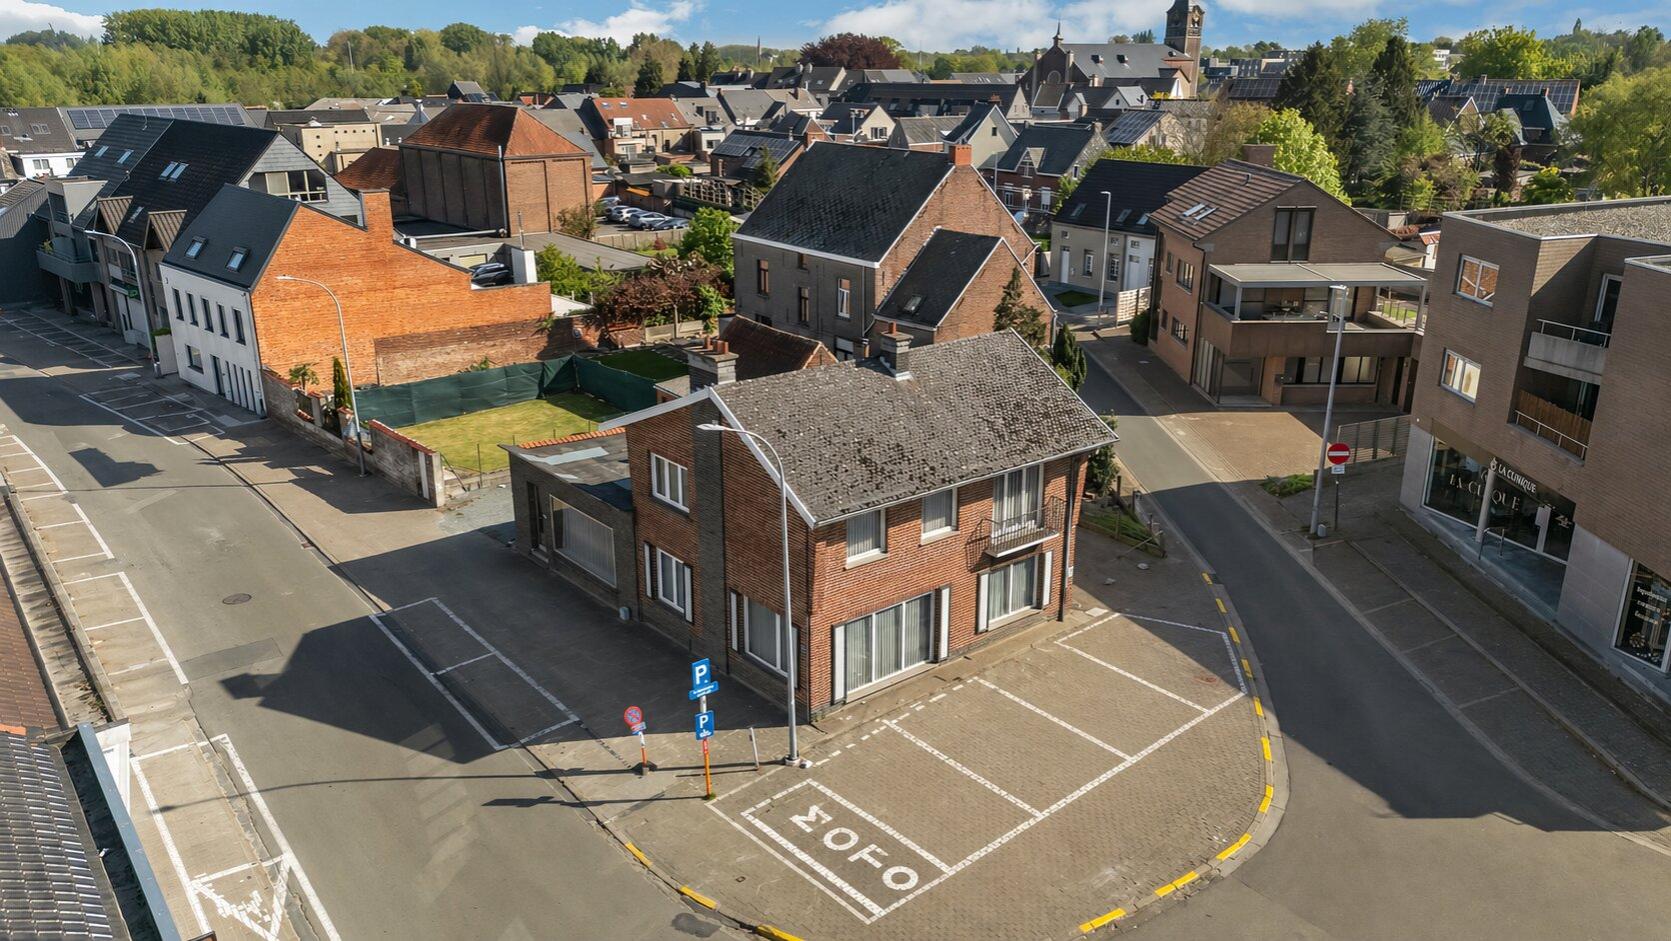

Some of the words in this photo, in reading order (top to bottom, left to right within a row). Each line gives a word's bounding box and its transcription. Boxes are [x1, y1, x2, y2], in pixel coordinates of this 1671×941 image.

[1498, 463, 1507, 477] LA
[1506, 469, 1537, 493] CLINIQUE
[695, 664, 708, 685] P
[699, 714, 709, 729] P
